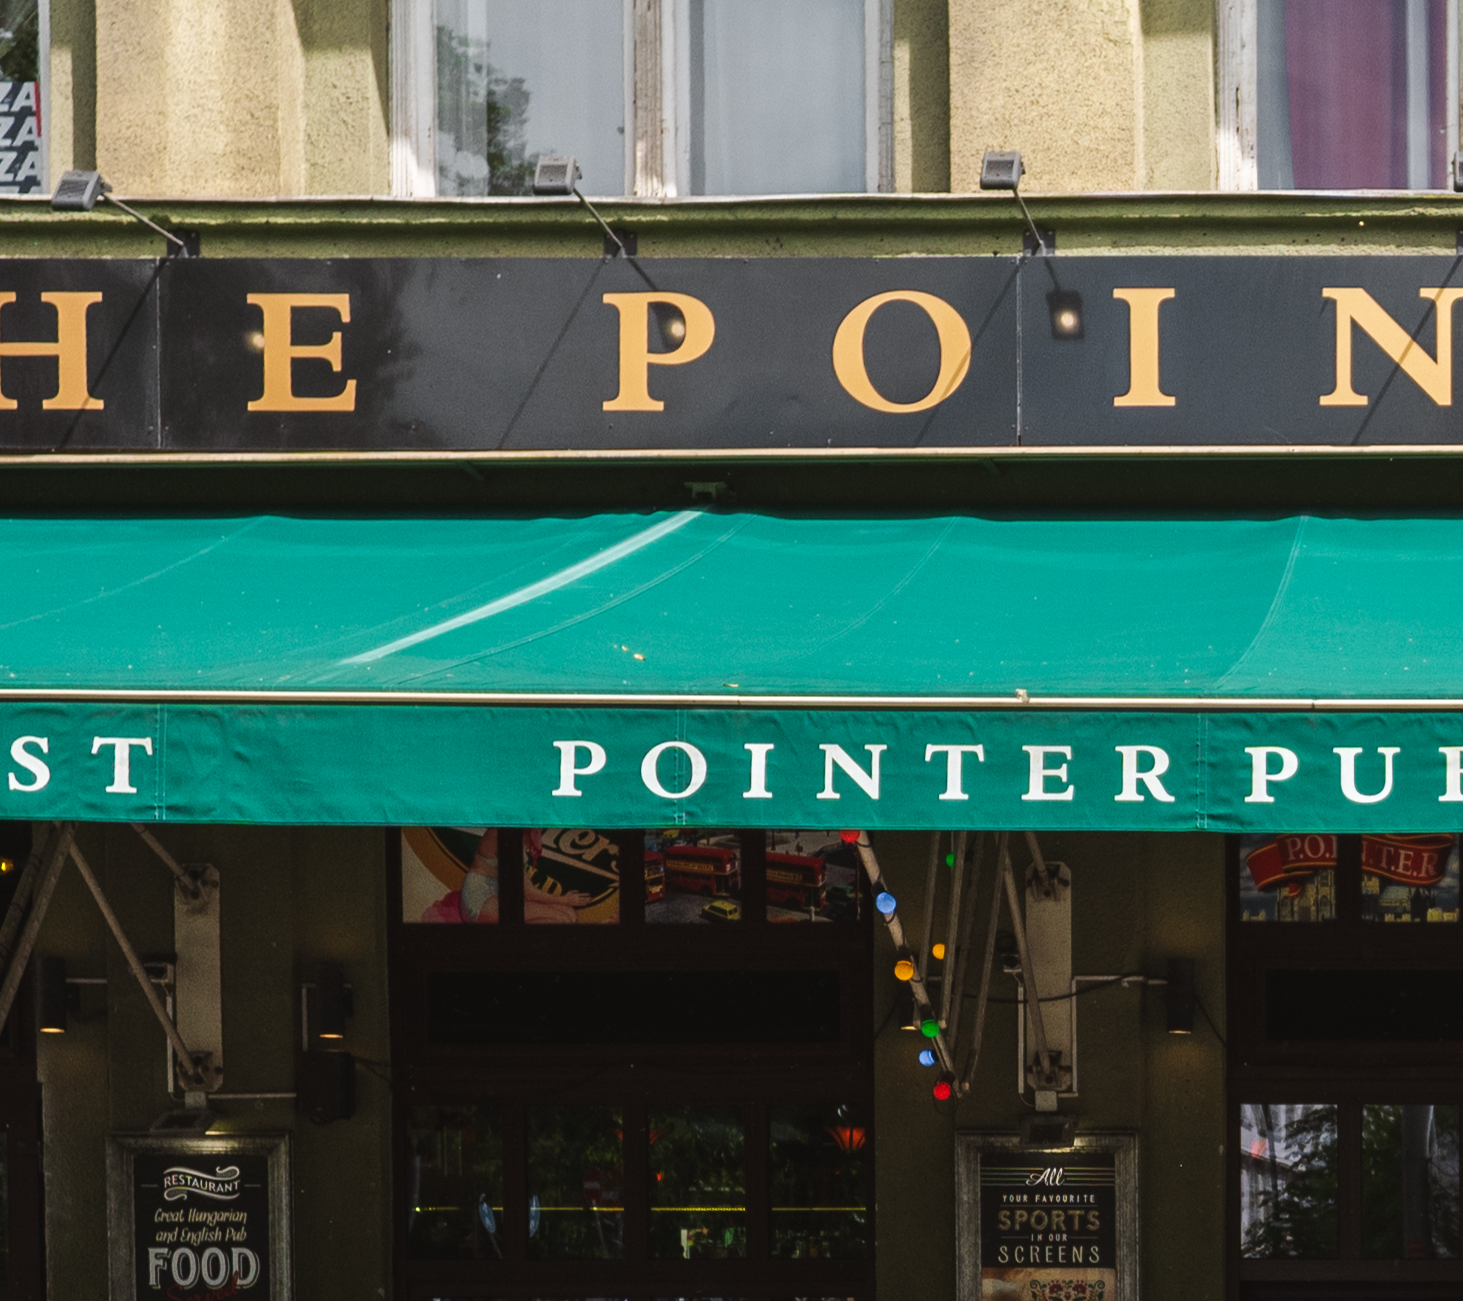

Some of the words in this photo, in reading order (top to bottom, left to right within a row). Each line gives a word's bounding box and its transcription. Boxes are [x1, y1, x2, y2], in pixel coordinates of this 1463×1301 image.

[551, 740, 1176, 803] POINTER
[164, 1173, 241, 1193] RESTAURANT
[1025, 1167, 1065, 1187] All
[1002, 1194, 1029, 1203] YOUR
[1035, 1194, 1096, 1203] FAVOURITE
[154, 1208, 185, 1223] Great
[188, 1208, 248, 1228] Hungarian
[997, 1210, 1101, 1231] SPORTS
[156, 1227, 179, 1244] and
[180, 1226, 223, 1247] English
[225, 1226, 248, 1242] Pub
[1031, 1233, 1043, 1242] IN
[1048, 1233, 1068, 1242] OUR
[998, 1245, 1100, 1264] SCREENS
[147, 1247, 261, 1290] FOOD
